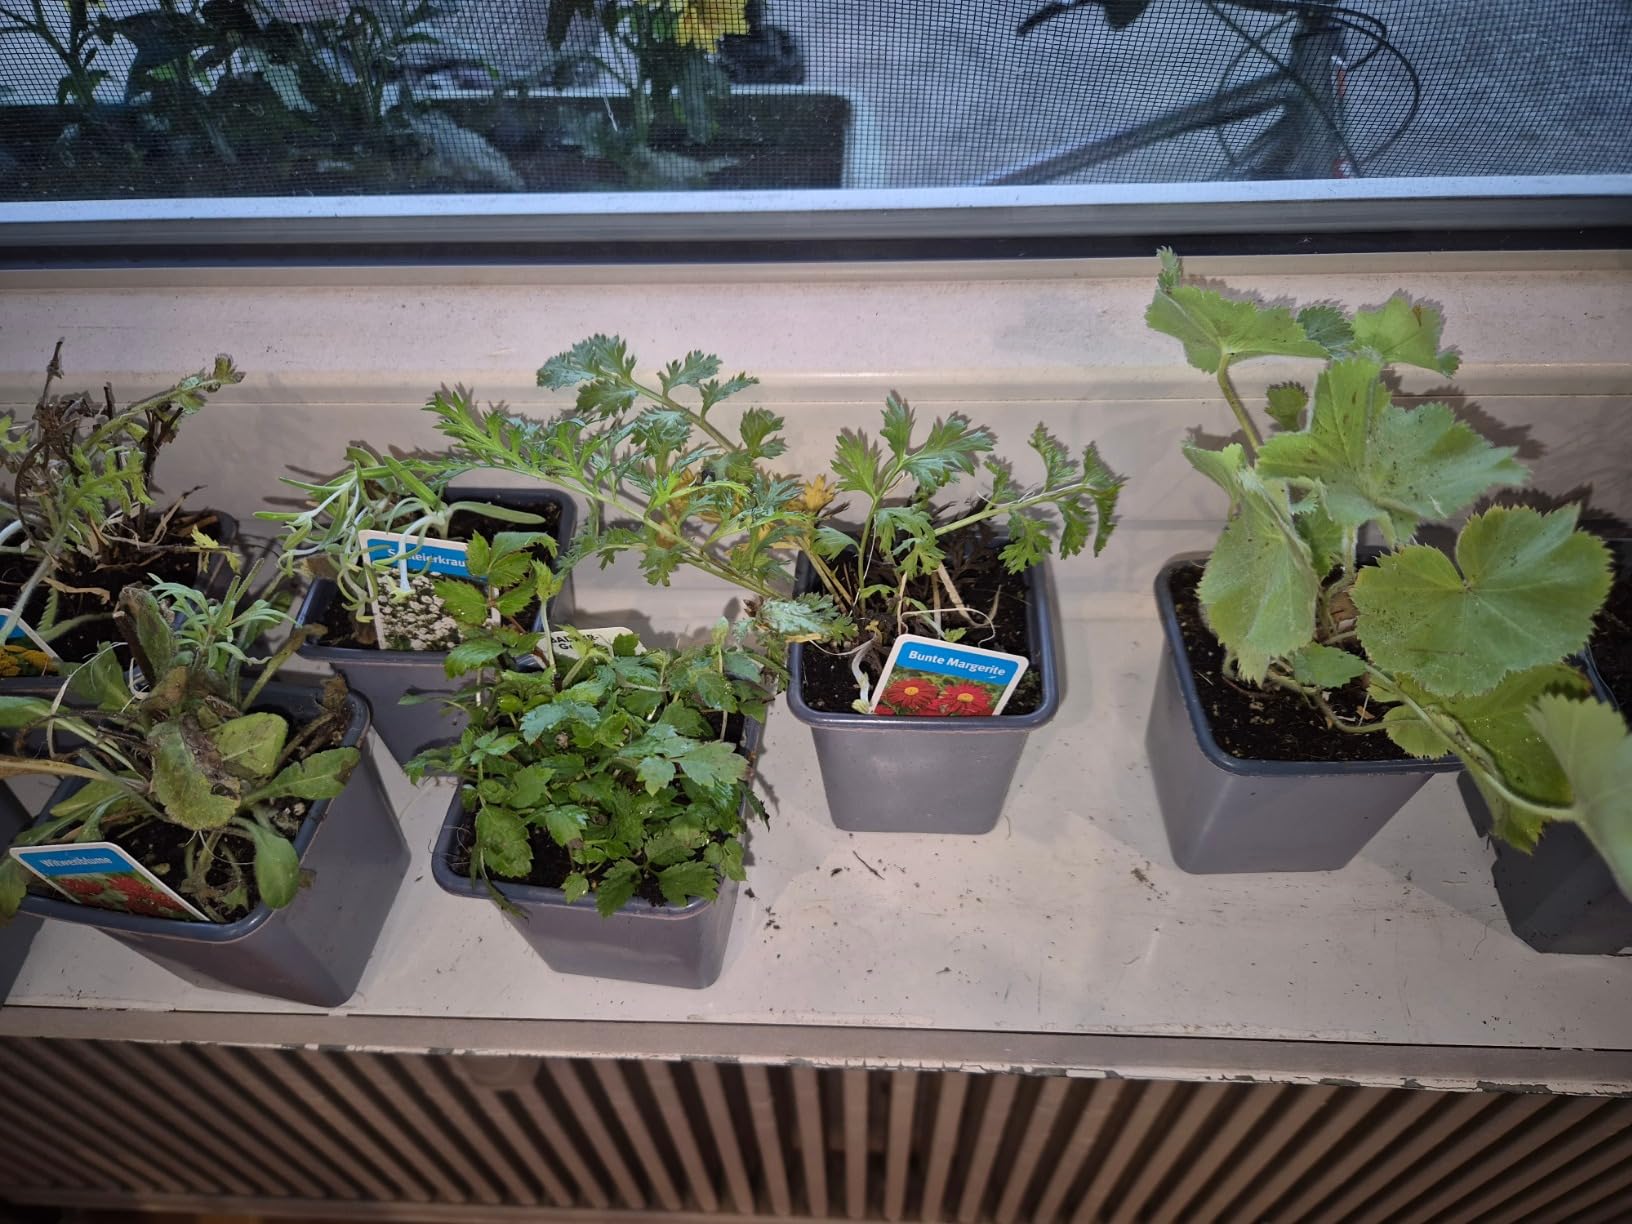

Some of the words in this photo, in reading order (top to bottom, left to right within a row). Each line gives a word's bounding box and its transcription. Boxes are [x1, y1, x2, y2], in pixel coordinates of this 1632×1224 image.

[387, 548, 466, 567] Sleierkrau
[908, 650, 945, 665] Bunte
[946, 657, 1006, 676] Margerite
